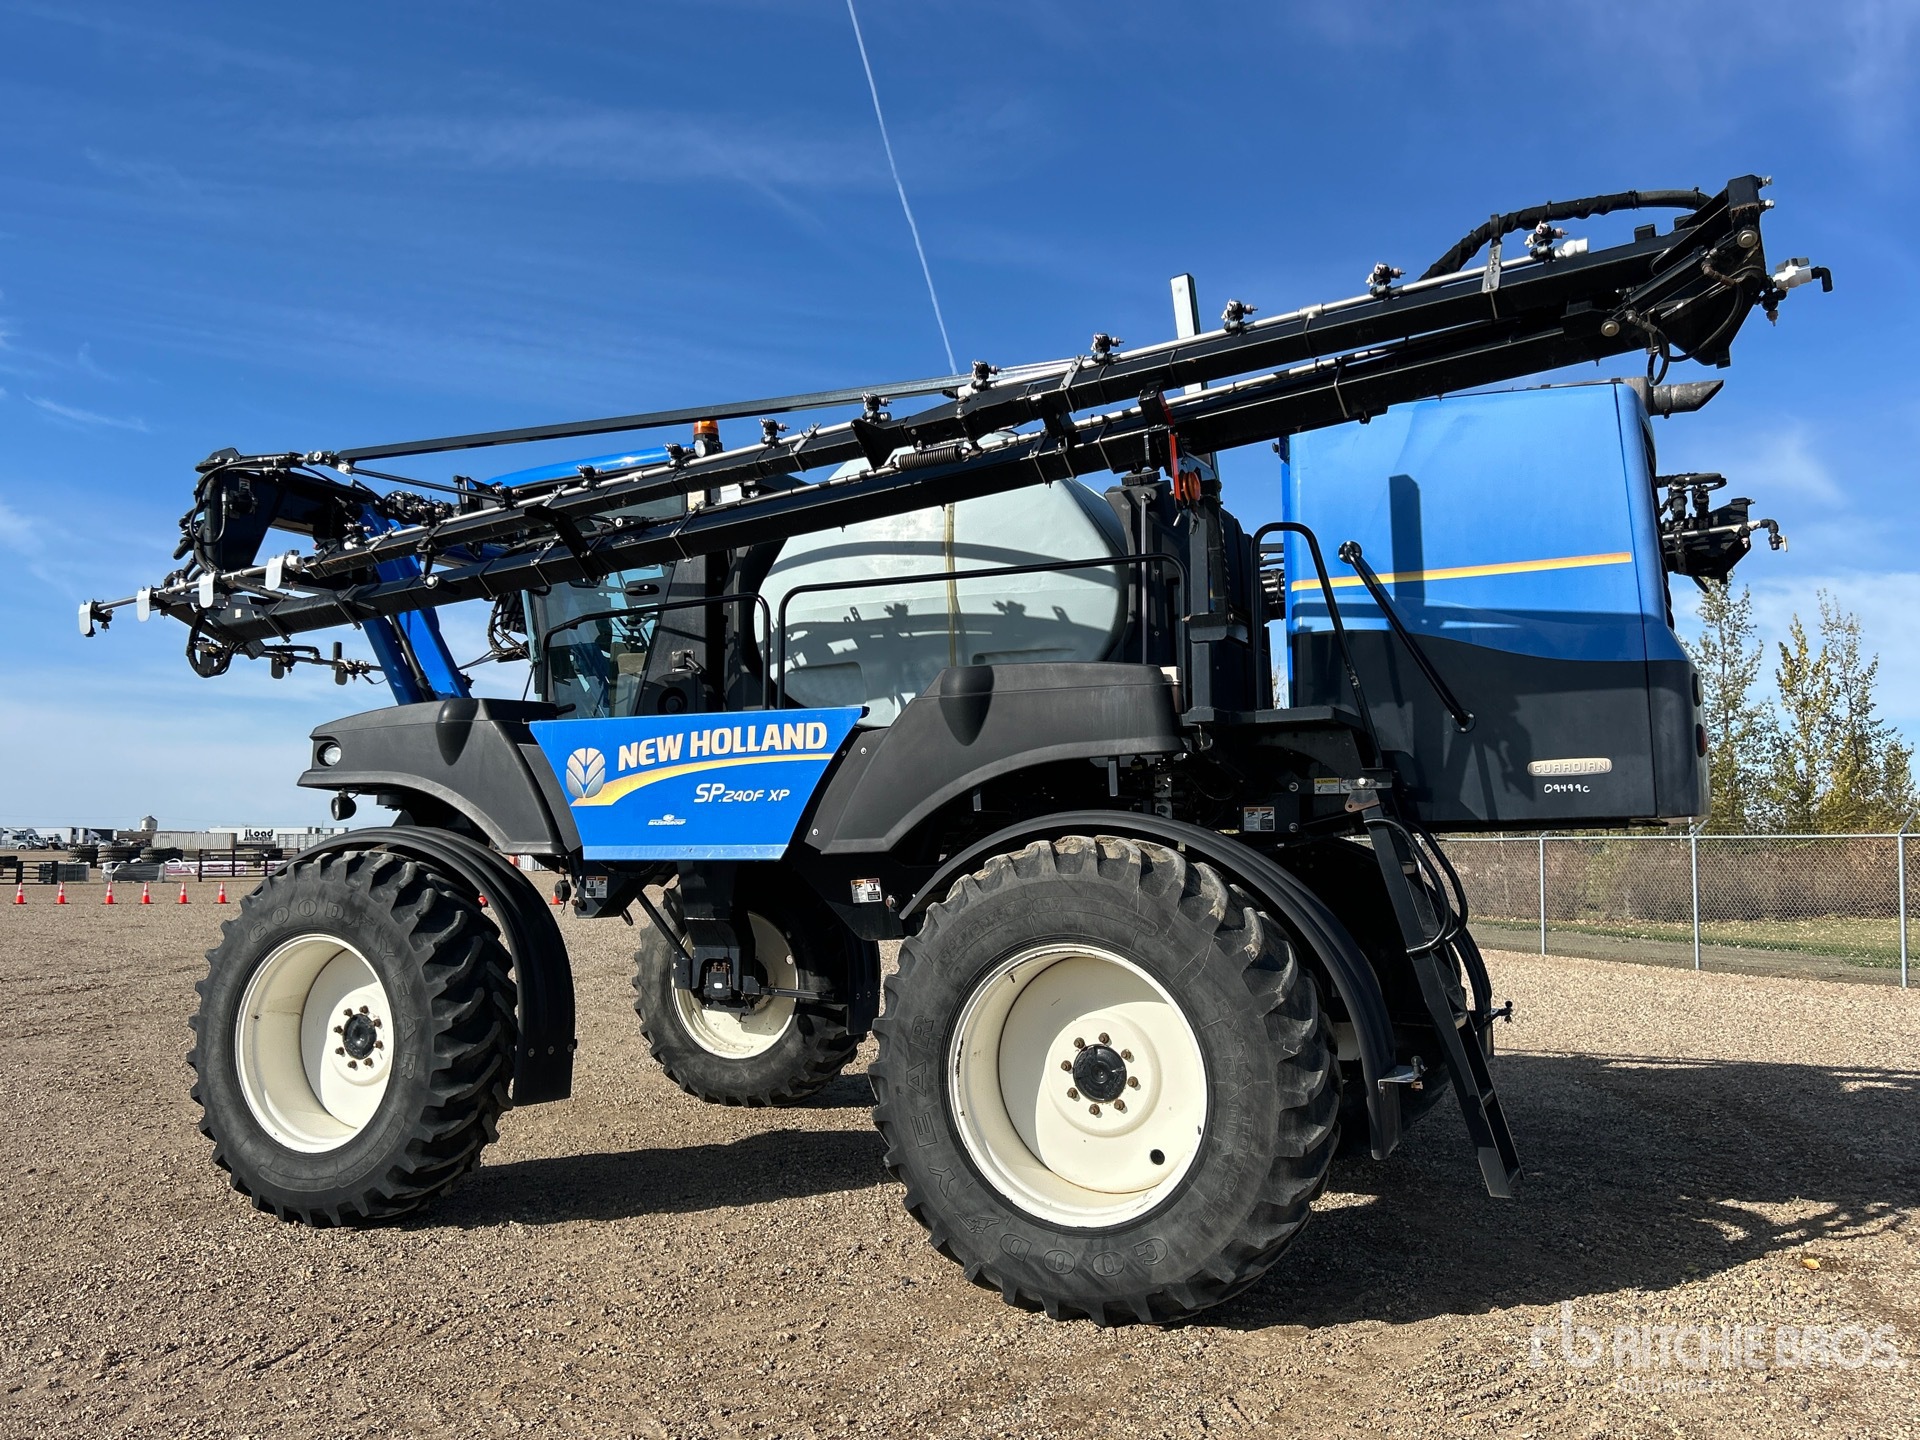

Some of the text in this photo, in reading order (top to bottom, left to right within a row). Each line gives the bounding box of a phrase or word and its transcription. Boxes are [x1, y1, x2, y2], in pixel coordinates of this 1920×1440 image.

[618, 722, 828, 772] NEW HOLLAND
[1533, 761, 1608, 774] GUARDIAN
[767, 789, 790, 802] XP
[245, 829, 274, 837] iLoad
[249, 900, 418, 1080] GOODYEAR
[906, 1014, 1168, 1278] GOODYEAR
